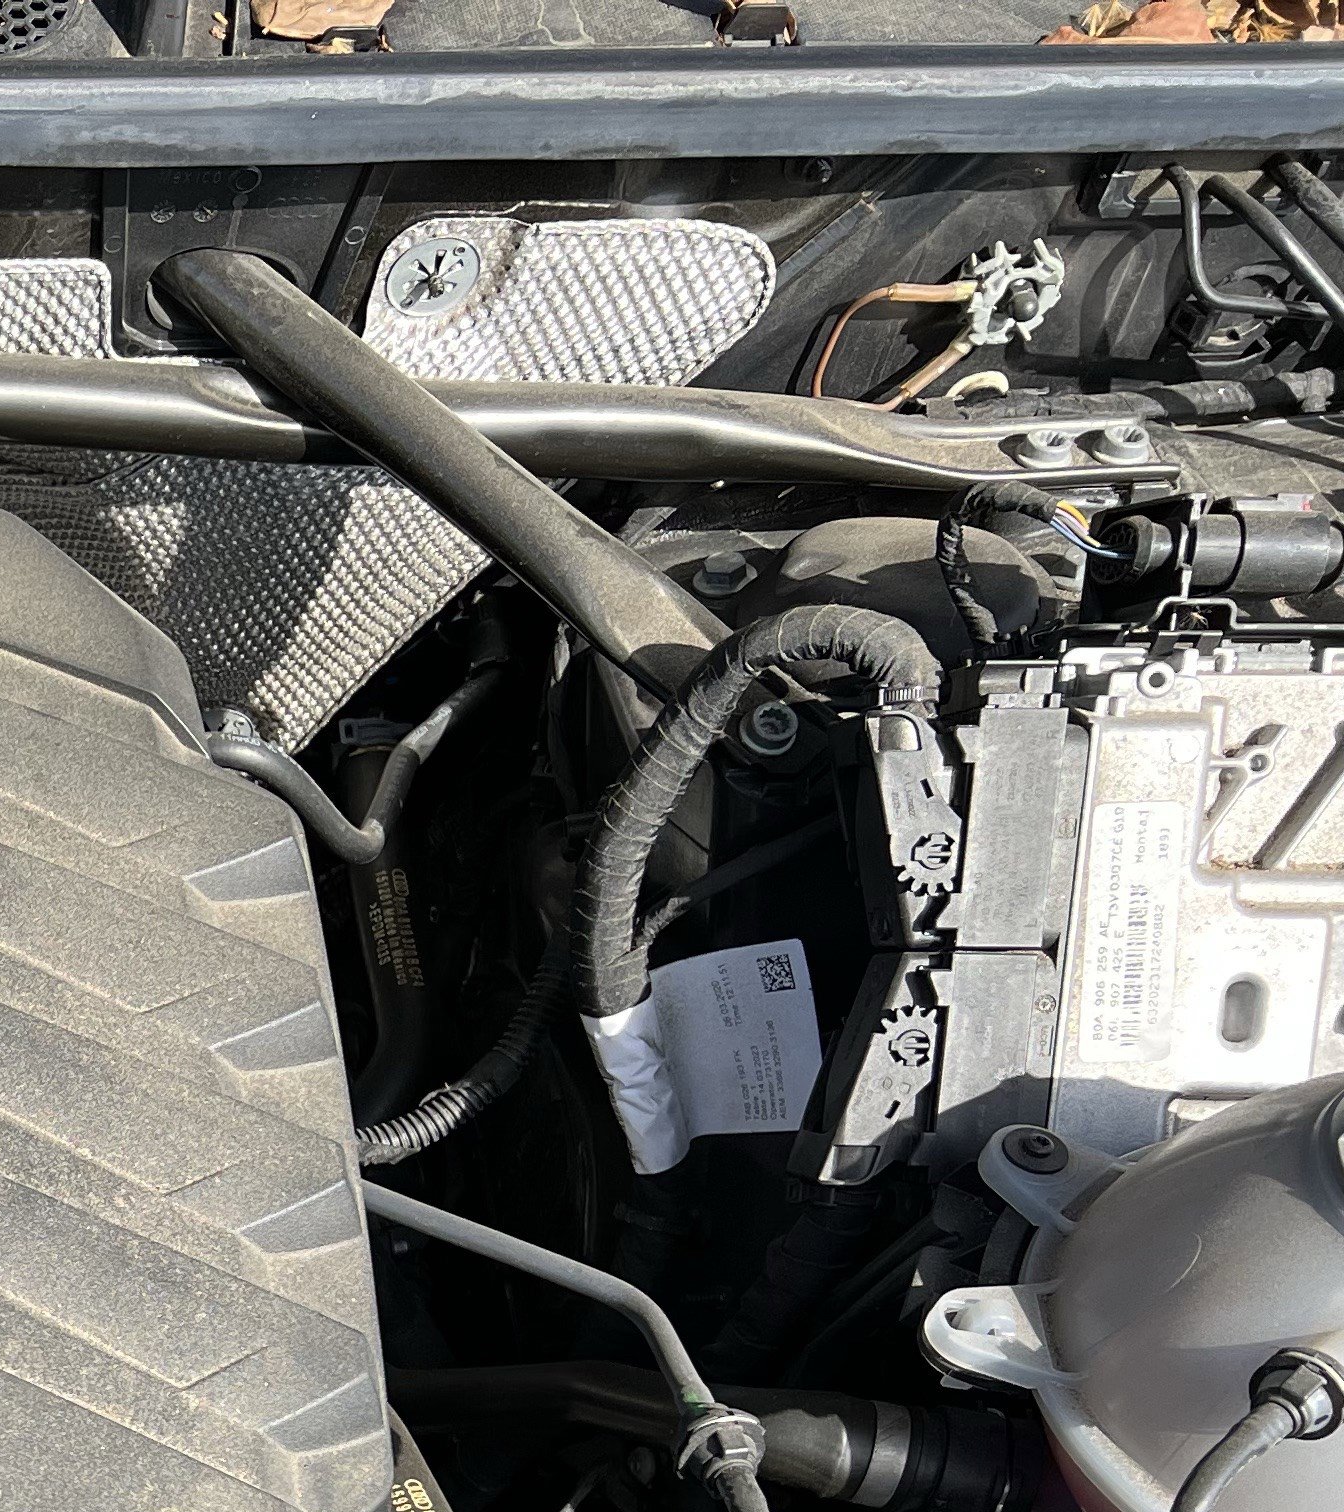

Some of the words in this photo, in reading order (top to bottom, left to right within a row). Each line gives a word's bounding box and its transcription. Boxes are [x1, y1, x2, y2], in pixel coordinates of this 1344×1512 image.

[1100, 919, 1110, 938] AE
[1097, 946, 1108, 972] 259
[1094, 980, 1106, 1007] 906
[1110, 984, 1121, 1008] 907
